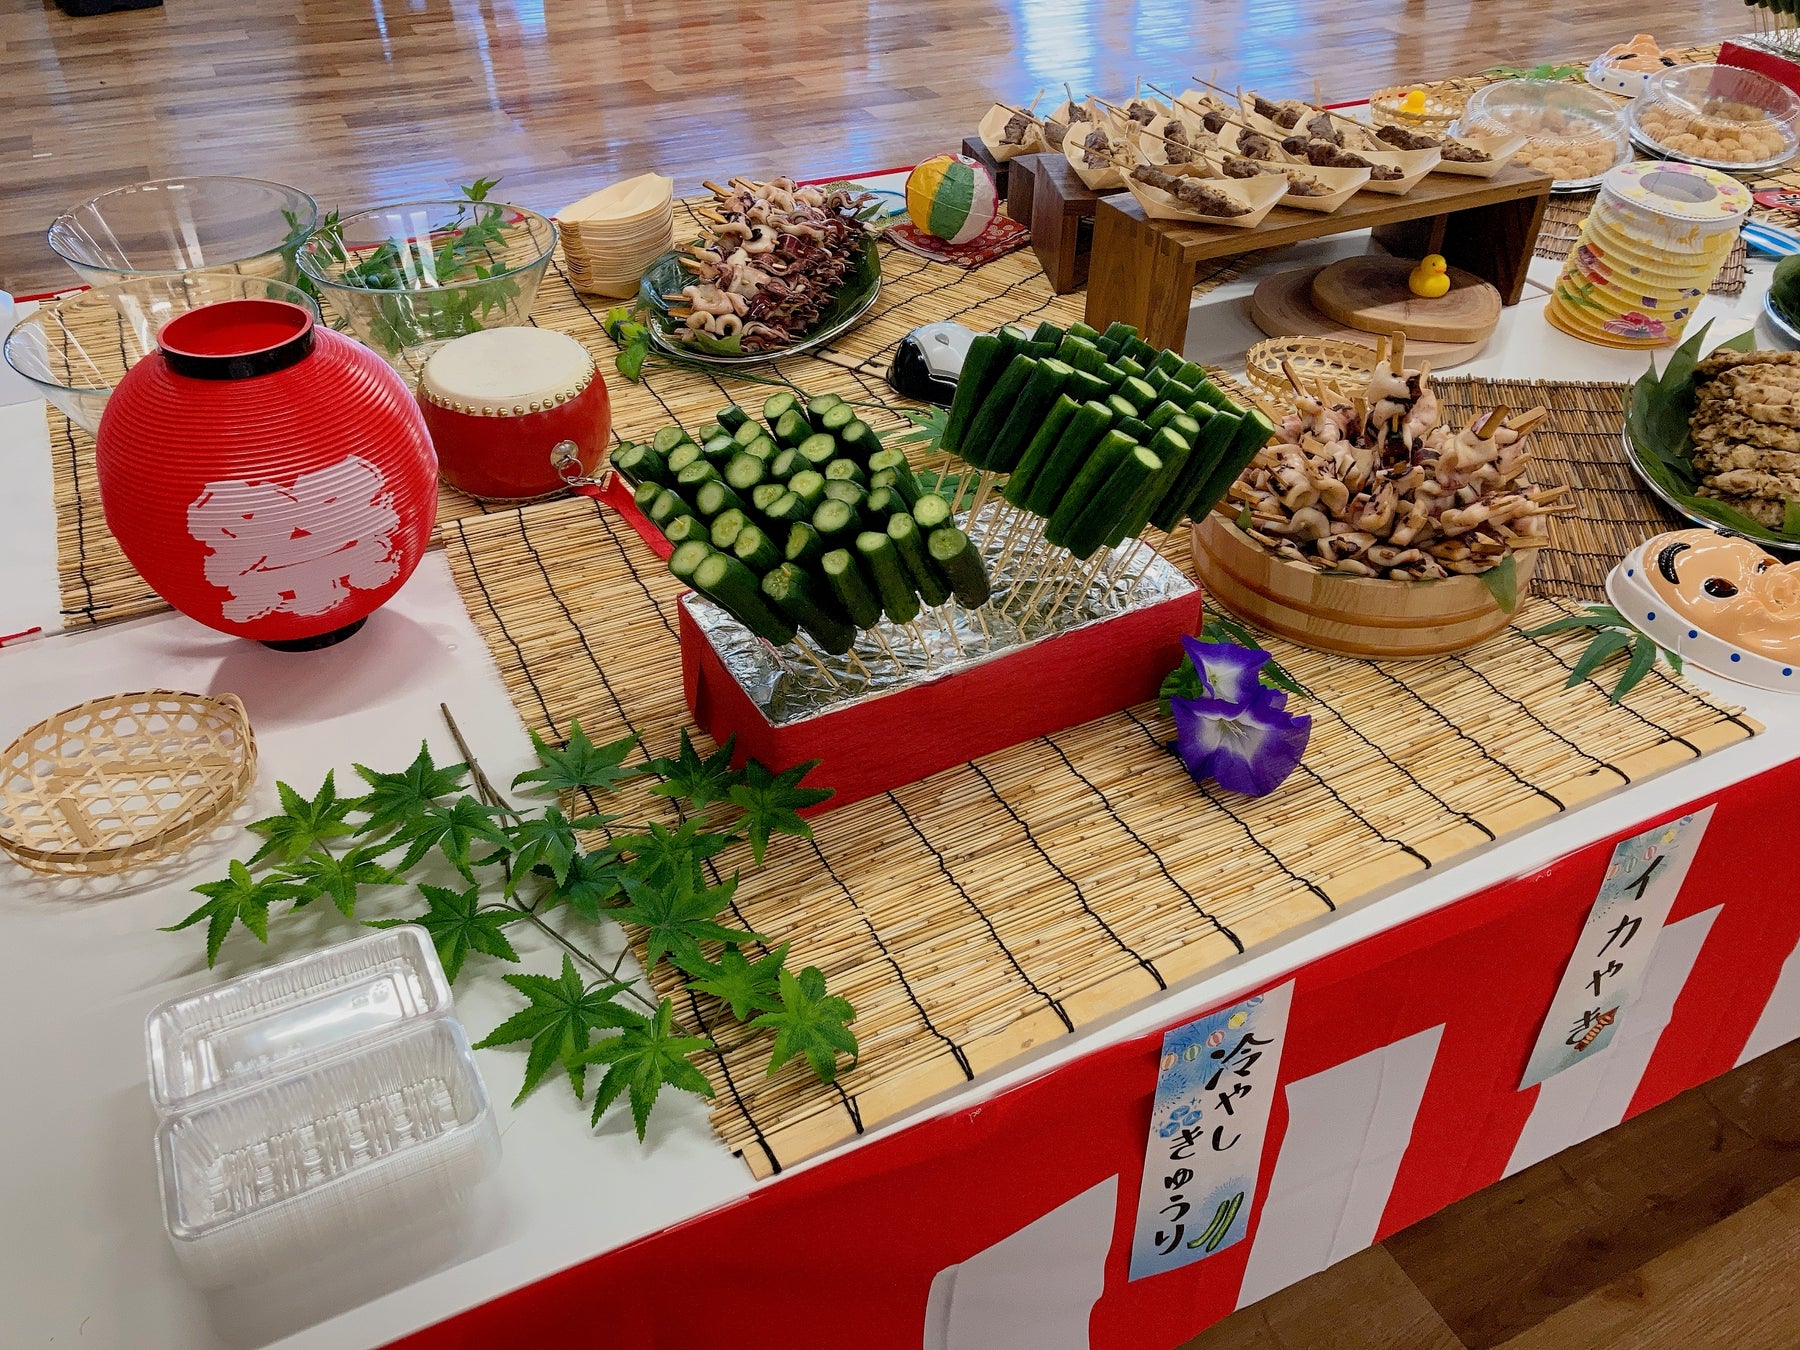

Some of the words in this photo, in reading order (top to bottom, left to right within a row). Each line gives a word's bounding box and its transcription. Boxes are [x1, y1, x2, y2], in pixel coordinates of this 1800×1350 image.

[1204, 1032, 1275, 1152] 冷やし
[1154, 1125, 1204, 1256] きゅうり
